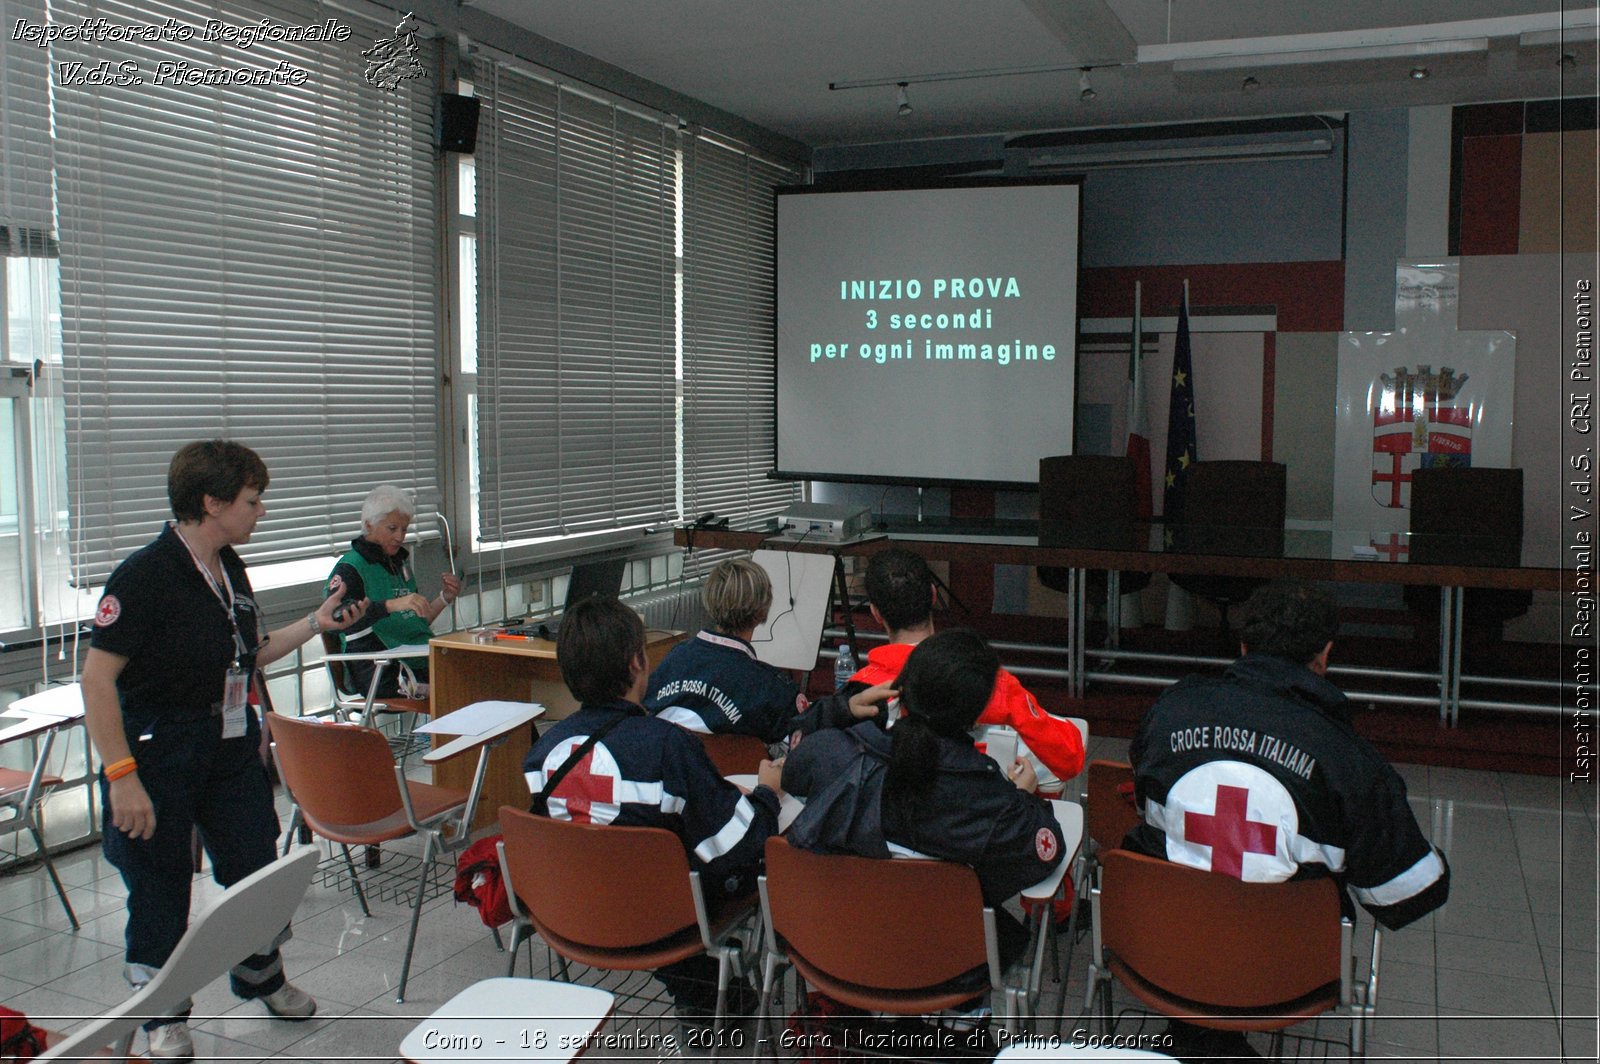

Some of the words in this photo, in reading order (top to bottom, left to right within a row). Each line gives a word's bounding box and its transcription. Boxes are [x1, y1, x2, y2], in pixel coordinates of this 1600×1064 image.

[840, 279, 922, 300] INIZIO
[933, 277, 1021, 299] PROVA
[866, 309, 878, 329] 3
[890, 308, 992, 329] secondi
[811, 342, 849, 362] per
[859, 339, 912, 364] ogni
[925, 339, 1056, 365] immagine
[656, 680, 681, 701] CROCE
[680, 679, 707, 697] ROSSA
[707, 686, 743, 725] ITALIANA
[1170, 726, 1210, 753] CROCE
[1213, 726, 1256, 753] ROSSA
[1258, 734, 1316, 781] ITALIANA
